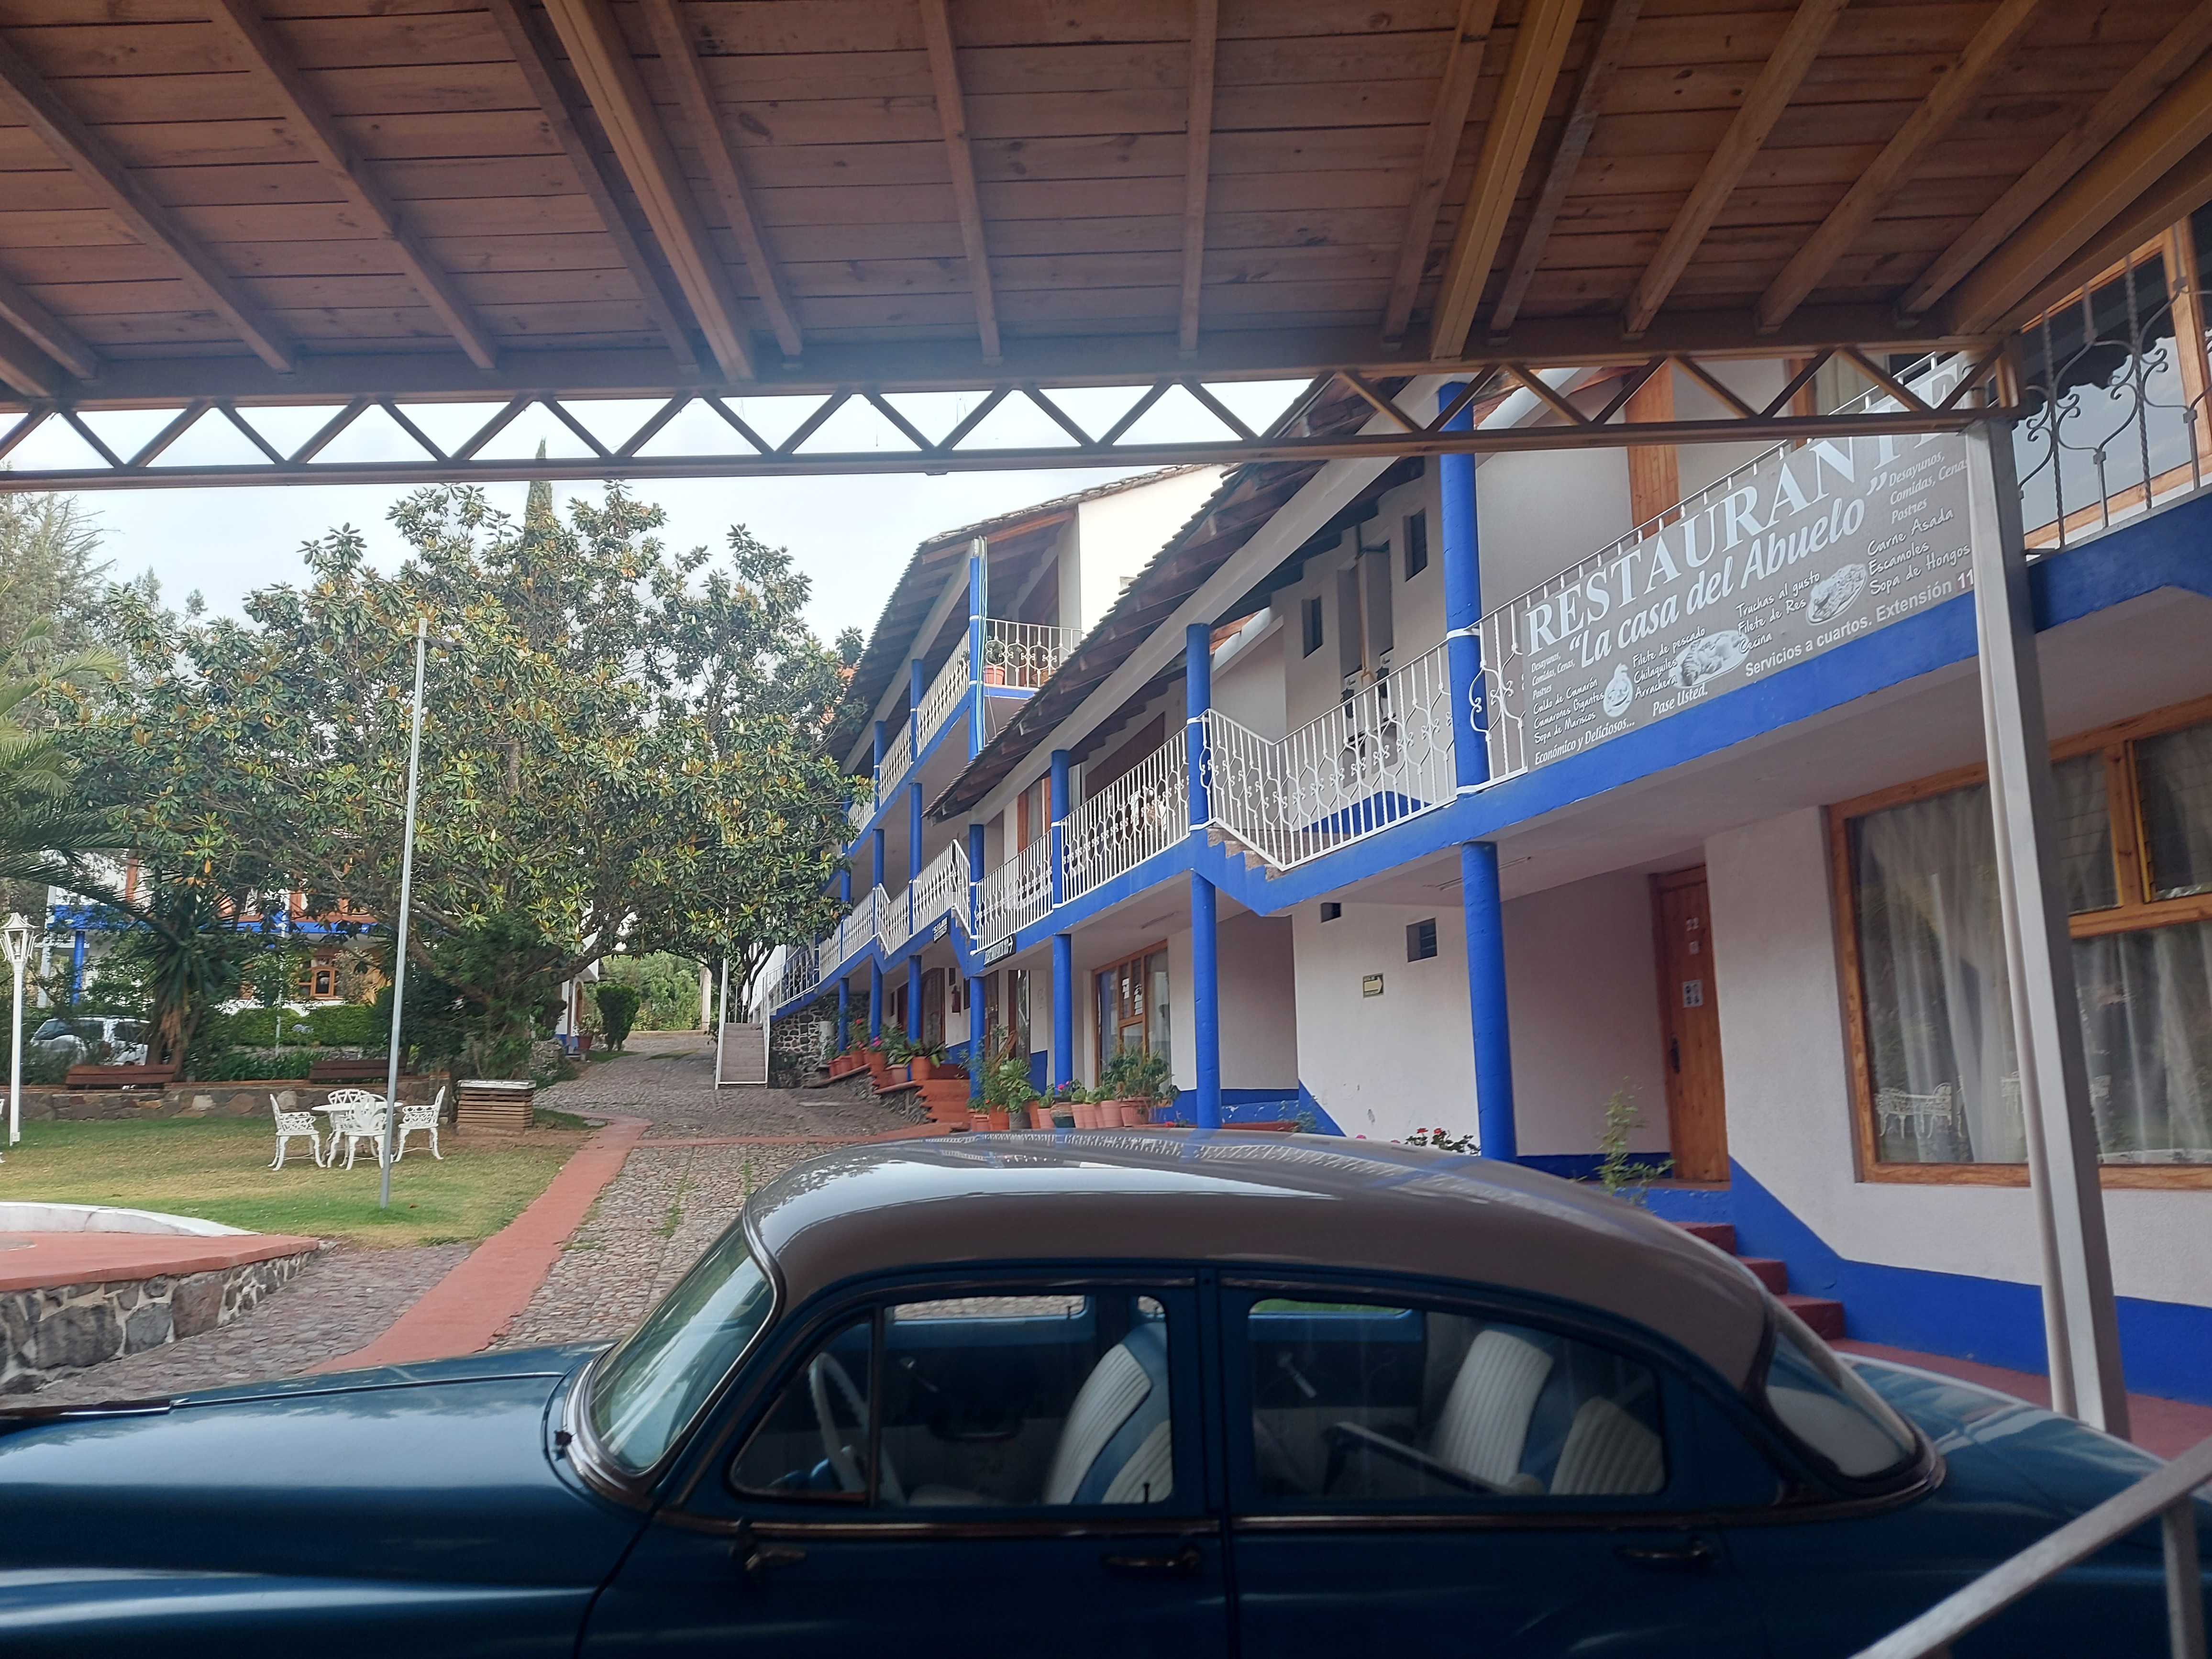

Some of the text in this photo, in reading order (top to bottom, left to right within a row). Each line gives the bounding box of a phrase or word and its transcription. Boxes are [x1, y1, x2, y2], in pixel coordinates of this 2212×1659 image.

[1889, 451, 1945, 487] Desayunos,
[1891, 476, 1936, 505] Comidas,
[1891, 498, 1927, 524] Postres
[1867, 508, 1954, 556] Carne Asada
[1868, 542, 1930, 575] Escamoles
[1869, 544, 1971, 595] Sopa de Hongos
[1617, 594, 1680, 649] casa
[1686, 555, 1735, 616] del
[1735, 570, 1820, 618] Truchas al gusto
[1737, 598, 1807, 636] Filete de Res
[1746, 644, 1802, 677] Servicios
[1805, 639, 1814, 652] a
[1816, 617, 1872, 647] cuartos.
[1875, 580, 1952, 622] Extensión
[1632, 626, 1706, 668] Filete de pescado
[1738, 632, 1772, 654] Cecina
[1634, 658, 1678, 684] Chilaquiles
[1635, 675, 1677, 700] Arrachera
[1532, 684, 1552, 700] Postres
[1533, 676, 1598, 715] Caldo de Camarón
[1652, 683, 1708, 717] Pase Usted.
[1534, 692, 1604, 730] Camarones Gigantes
[1534, 711, 1596, 745] Sopa de Mariscos
[1534, 739, 1576, 765] Económico
[1577, 737, 1584, 752] y
